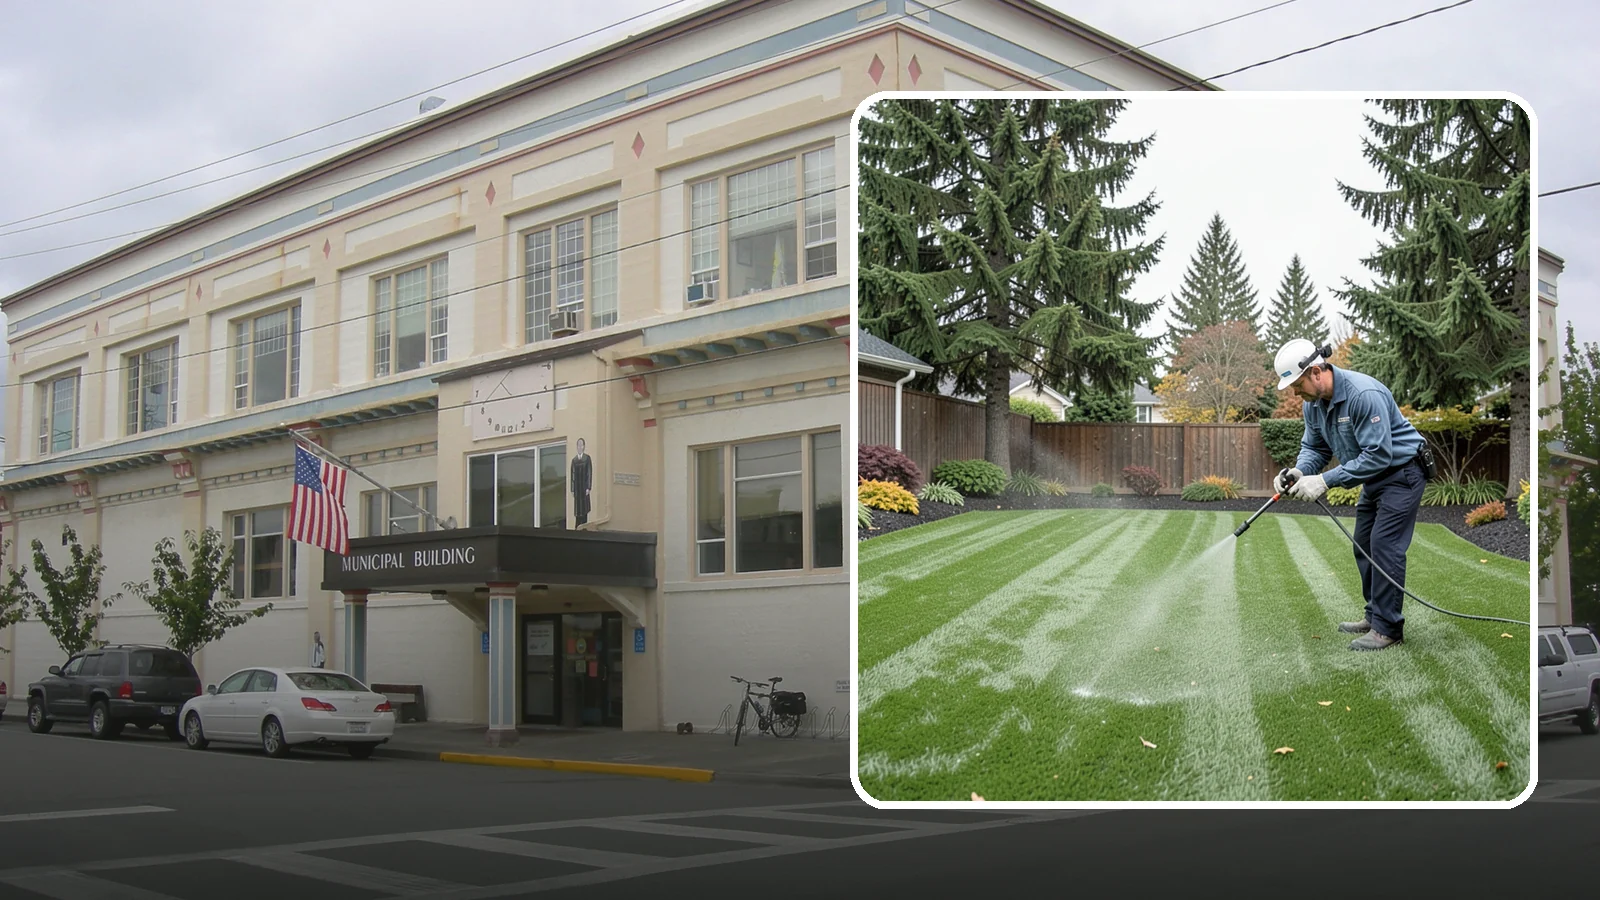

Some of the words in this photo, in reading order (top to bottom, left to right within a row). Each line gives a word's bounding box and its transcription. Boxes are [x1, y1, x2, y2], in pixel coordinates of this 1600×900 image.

[475, 390, 479, 398] 7
[536, 402, 540, 410] 4
[481, 407, 485, 415] 8
[529, 414, 533, 422] 3
[521, 420, 525, 428] 2
[508, 425, 513, 433] 12
[342, 552, 405, 572] MUNICIPAL
[414, 546, 475, 567] BUILDING
